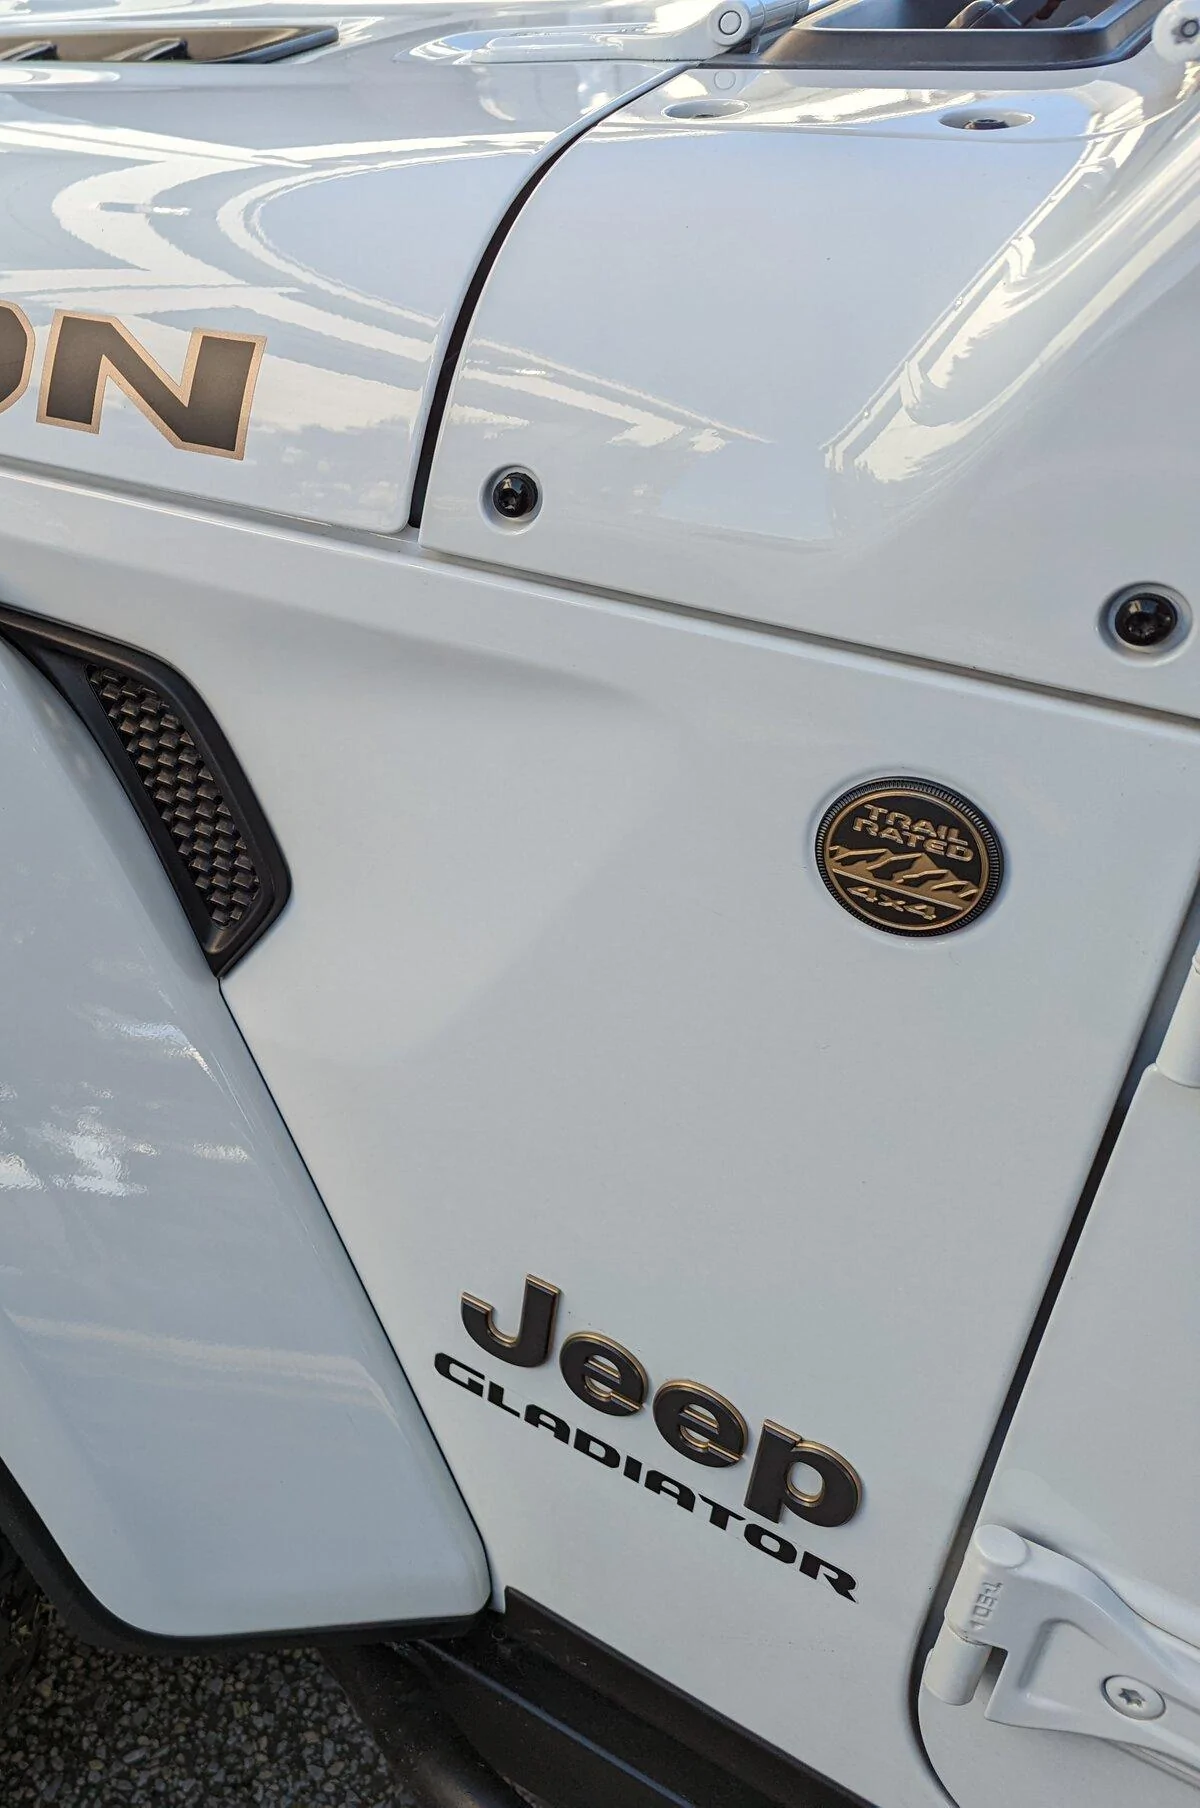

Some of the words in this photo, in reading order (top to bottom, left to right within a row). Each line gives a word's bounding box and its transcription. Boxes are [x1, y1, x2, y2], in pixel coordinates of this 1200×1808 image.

[852, 817, 974, 863] RATED
[863, 803, 969, 846] TRAIL
[460, 1272, 864, 1528] Jeep
[433, 1351, 858, 1604] GLADIATOR
